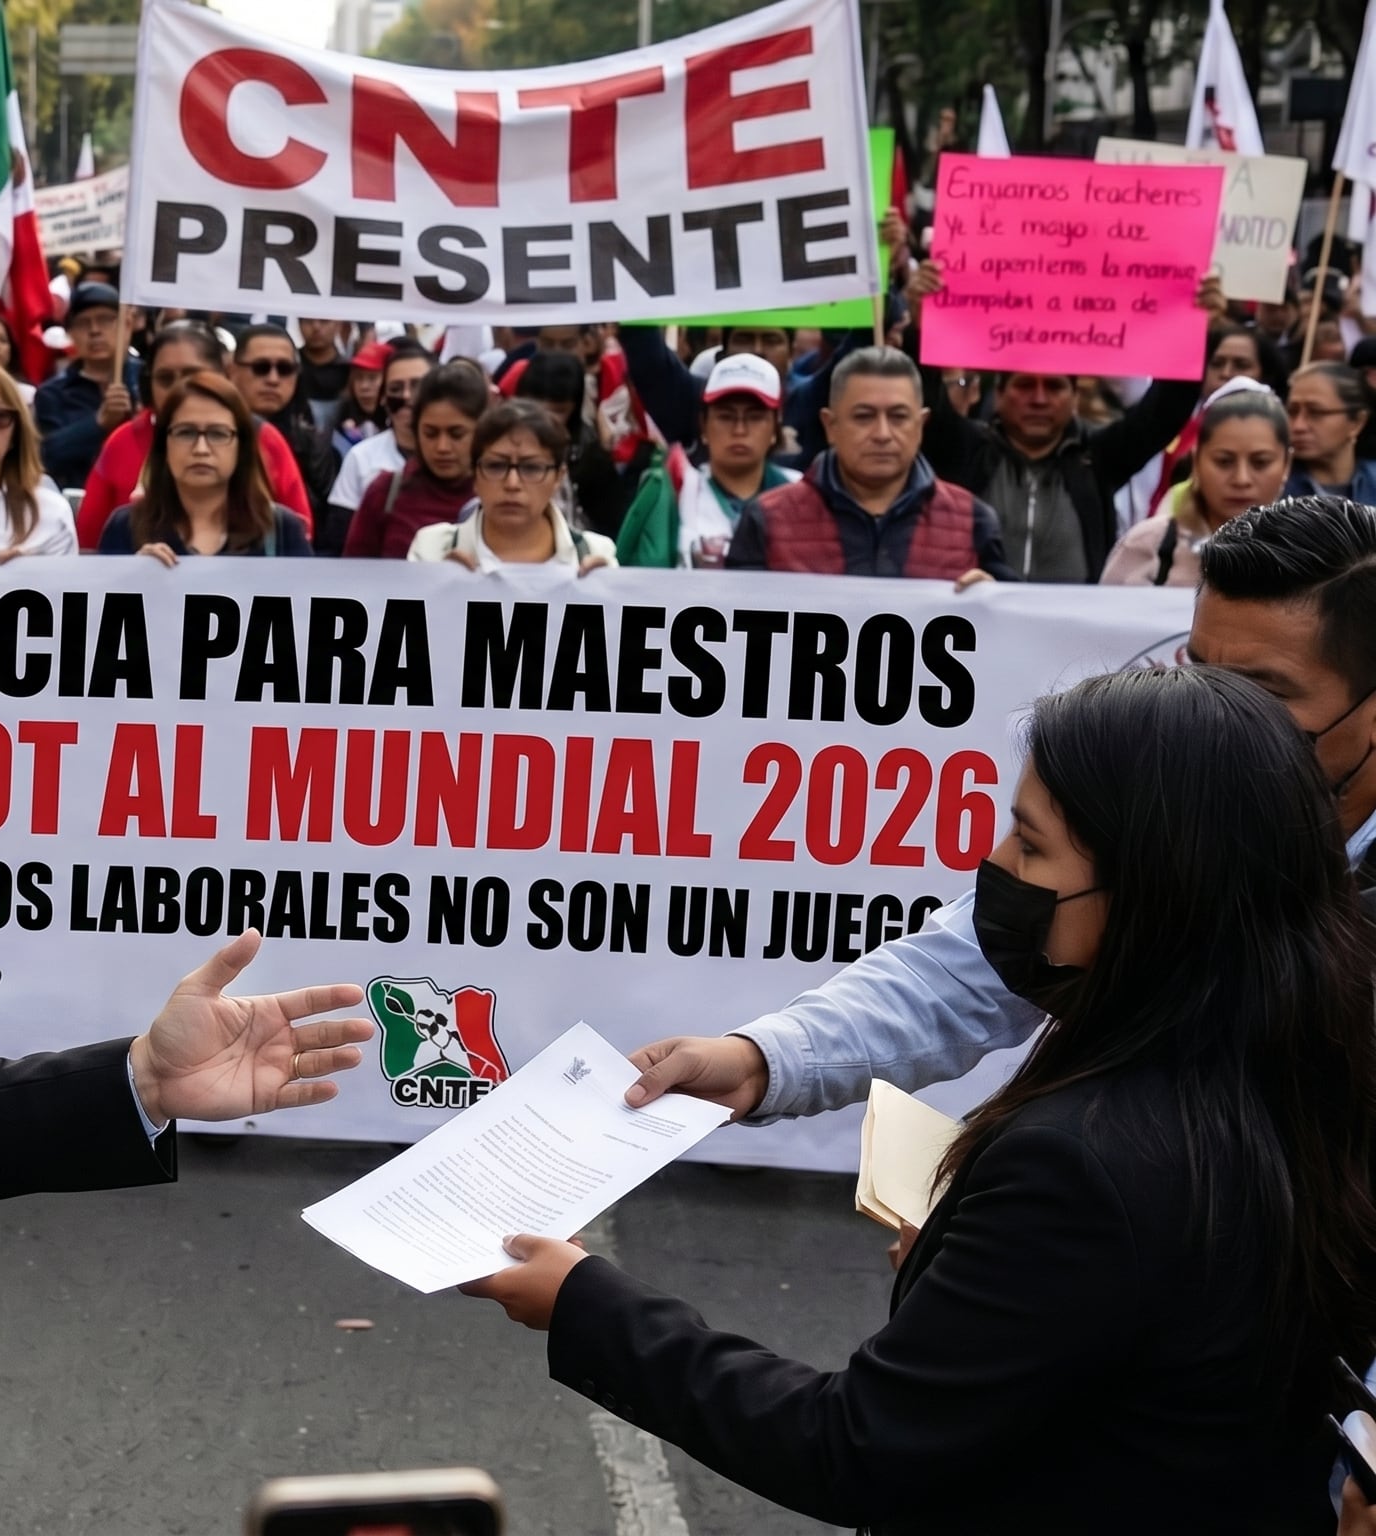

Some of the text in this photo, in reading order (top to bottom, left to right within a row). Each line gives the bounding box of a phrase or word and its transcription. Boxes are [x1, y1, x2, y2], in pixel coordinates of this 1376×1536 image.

[180, 27, 824, 206] CNTE
[151, 189, 857, 305] PRESENTE
[179, 593, 434, 707] PARA
[461, 601, 978, 728] MAESTROS
[98, 723, 217, 839] AL
[246, 726, 712, 858] MUNDIAL
[740, 742, 998, 872] 2026
[70, 864, 410, 944] LABORALES
[427, 875, 510, 948] NO
[526, 878, 651, 954] SON
[667, 885, 750, 958] UN
